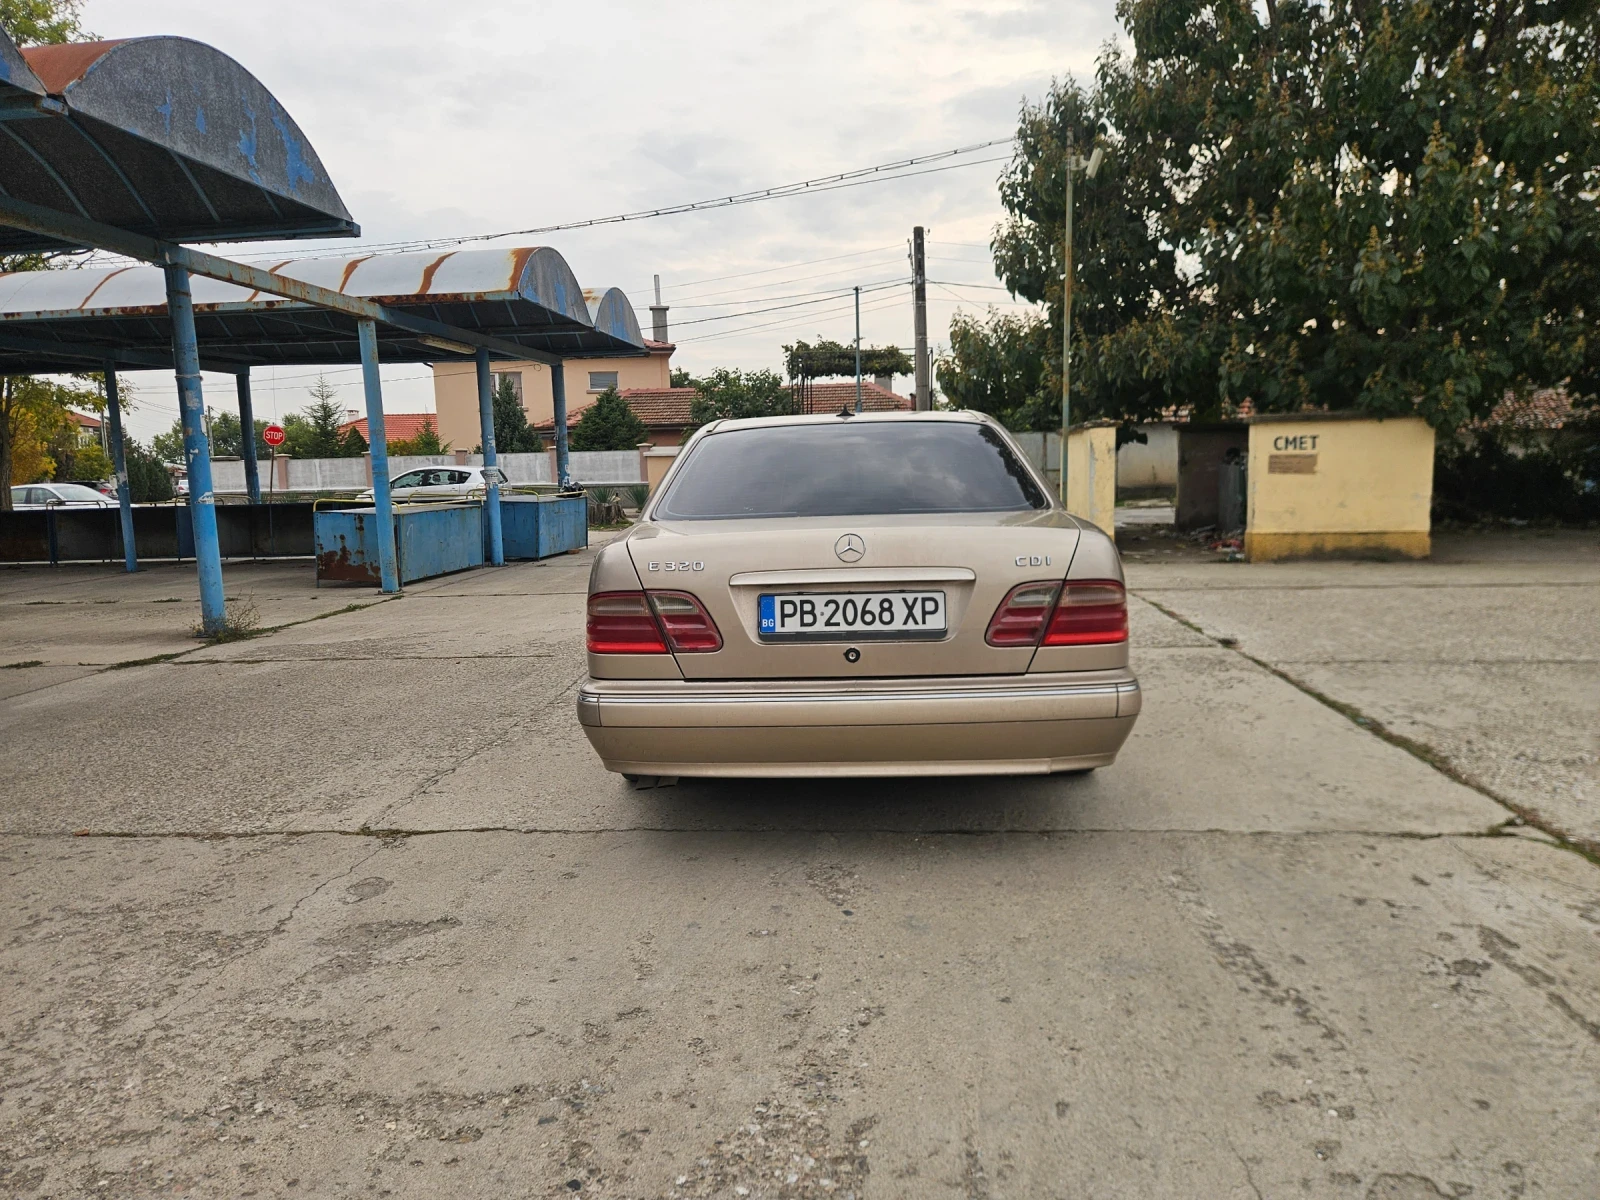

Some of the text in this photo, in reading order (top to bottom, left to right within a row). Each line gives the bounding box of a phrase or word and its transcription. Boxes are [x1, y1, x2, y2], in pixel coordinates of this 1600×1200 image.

[265, 431, 283, 441] STOP
[648, 561, 705, 571] E 320
[1015, 555, 1052, 567] CDI
[824, 598, 895, 627] 2068
[902, 596, 939, 626] XP
[762, 619, 774, 627] BG
